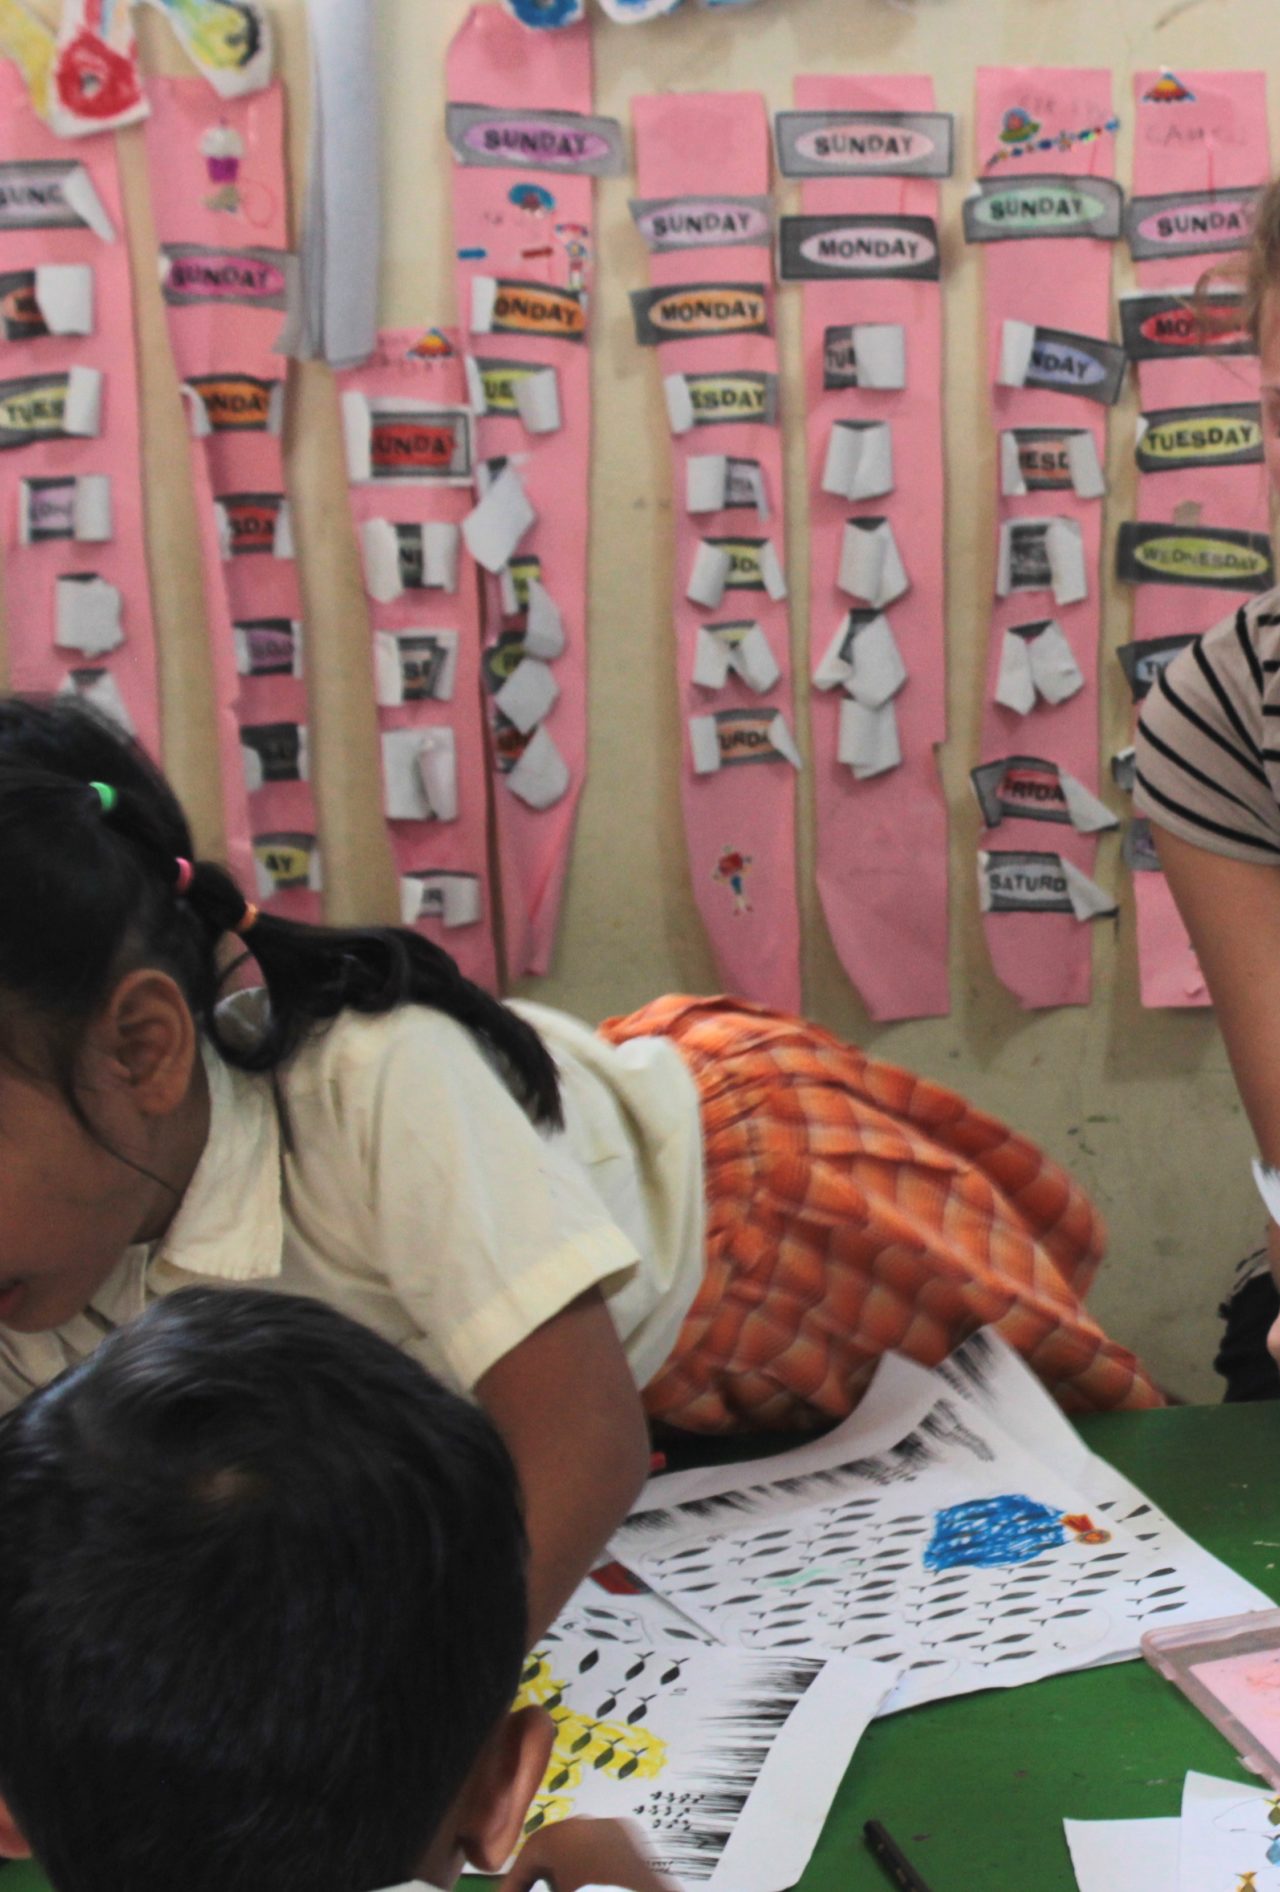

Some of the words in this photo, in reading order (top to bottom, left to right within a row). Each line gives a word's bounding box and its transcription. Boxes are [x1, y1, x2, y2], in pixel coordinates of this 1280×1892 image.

[484, 129, 588, 156] SUNDAY
[814, 135, 913, 157] SUNDAY
[989, 197, 1083, 221] SUNDAY
[653, 212, 751, 237] SUNDAY
[1156, 211, 1241, 239] SUNDA
[818, 237, 919, 259] MONDAY
[171, 265, 268, 288] SUNDAY
[494, 296, 577, 326] ONDAY
[661, 299, 760, 322] MONDAY
[1031, 349, 1089, 380] NDAY
[689, 388, 768, 411] ESDAY
[1147, 426, 1253, 451] TUESDAY
[1142, 544, 1260, 571] WEDNESDAY
[989, 873, 1068, 893] SATURD
